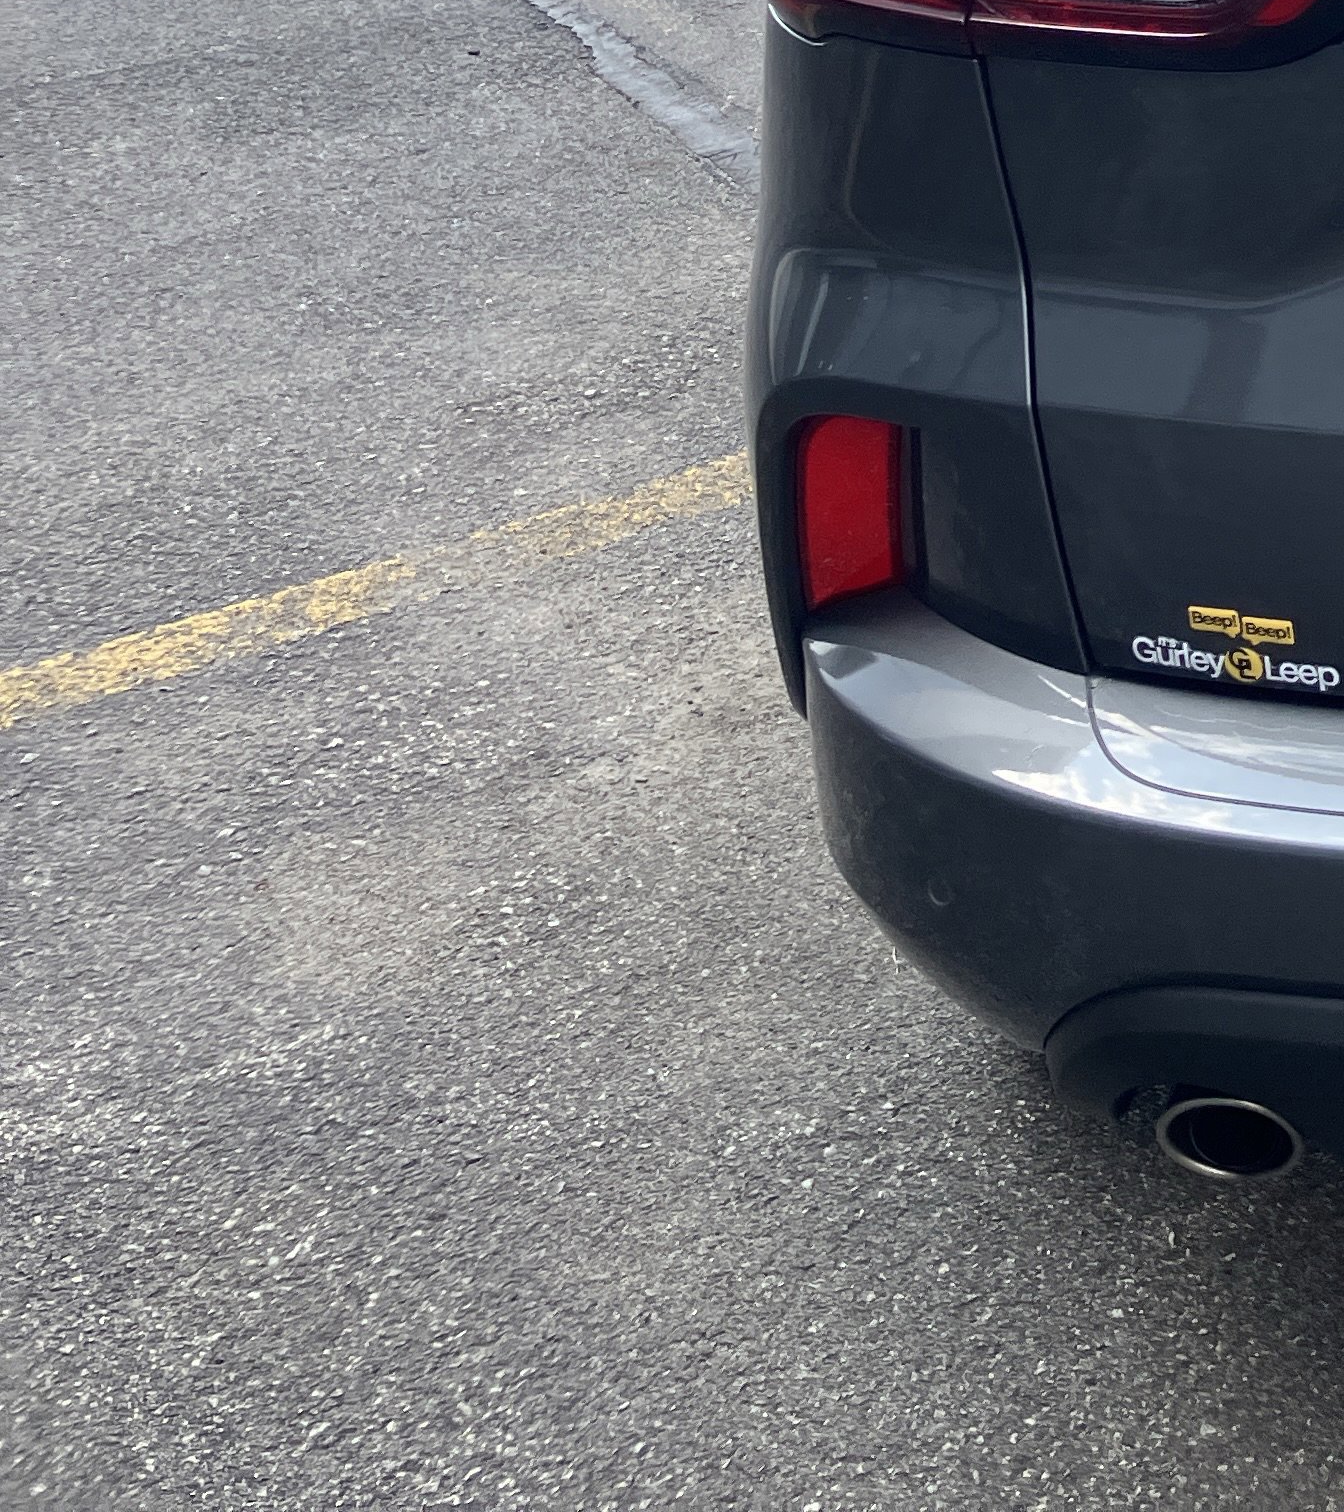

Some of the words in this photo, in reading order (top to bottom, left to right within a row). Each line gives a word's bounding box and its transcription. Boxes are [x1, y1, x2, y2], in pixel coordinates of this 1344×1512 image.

[1191, 611, 1237, 629] Beep!
[1245, 622, 1292, 640] Beep!
[1132, 636, 1225, 678] Gurley
[1264, 655, 1340, 692] Leep
